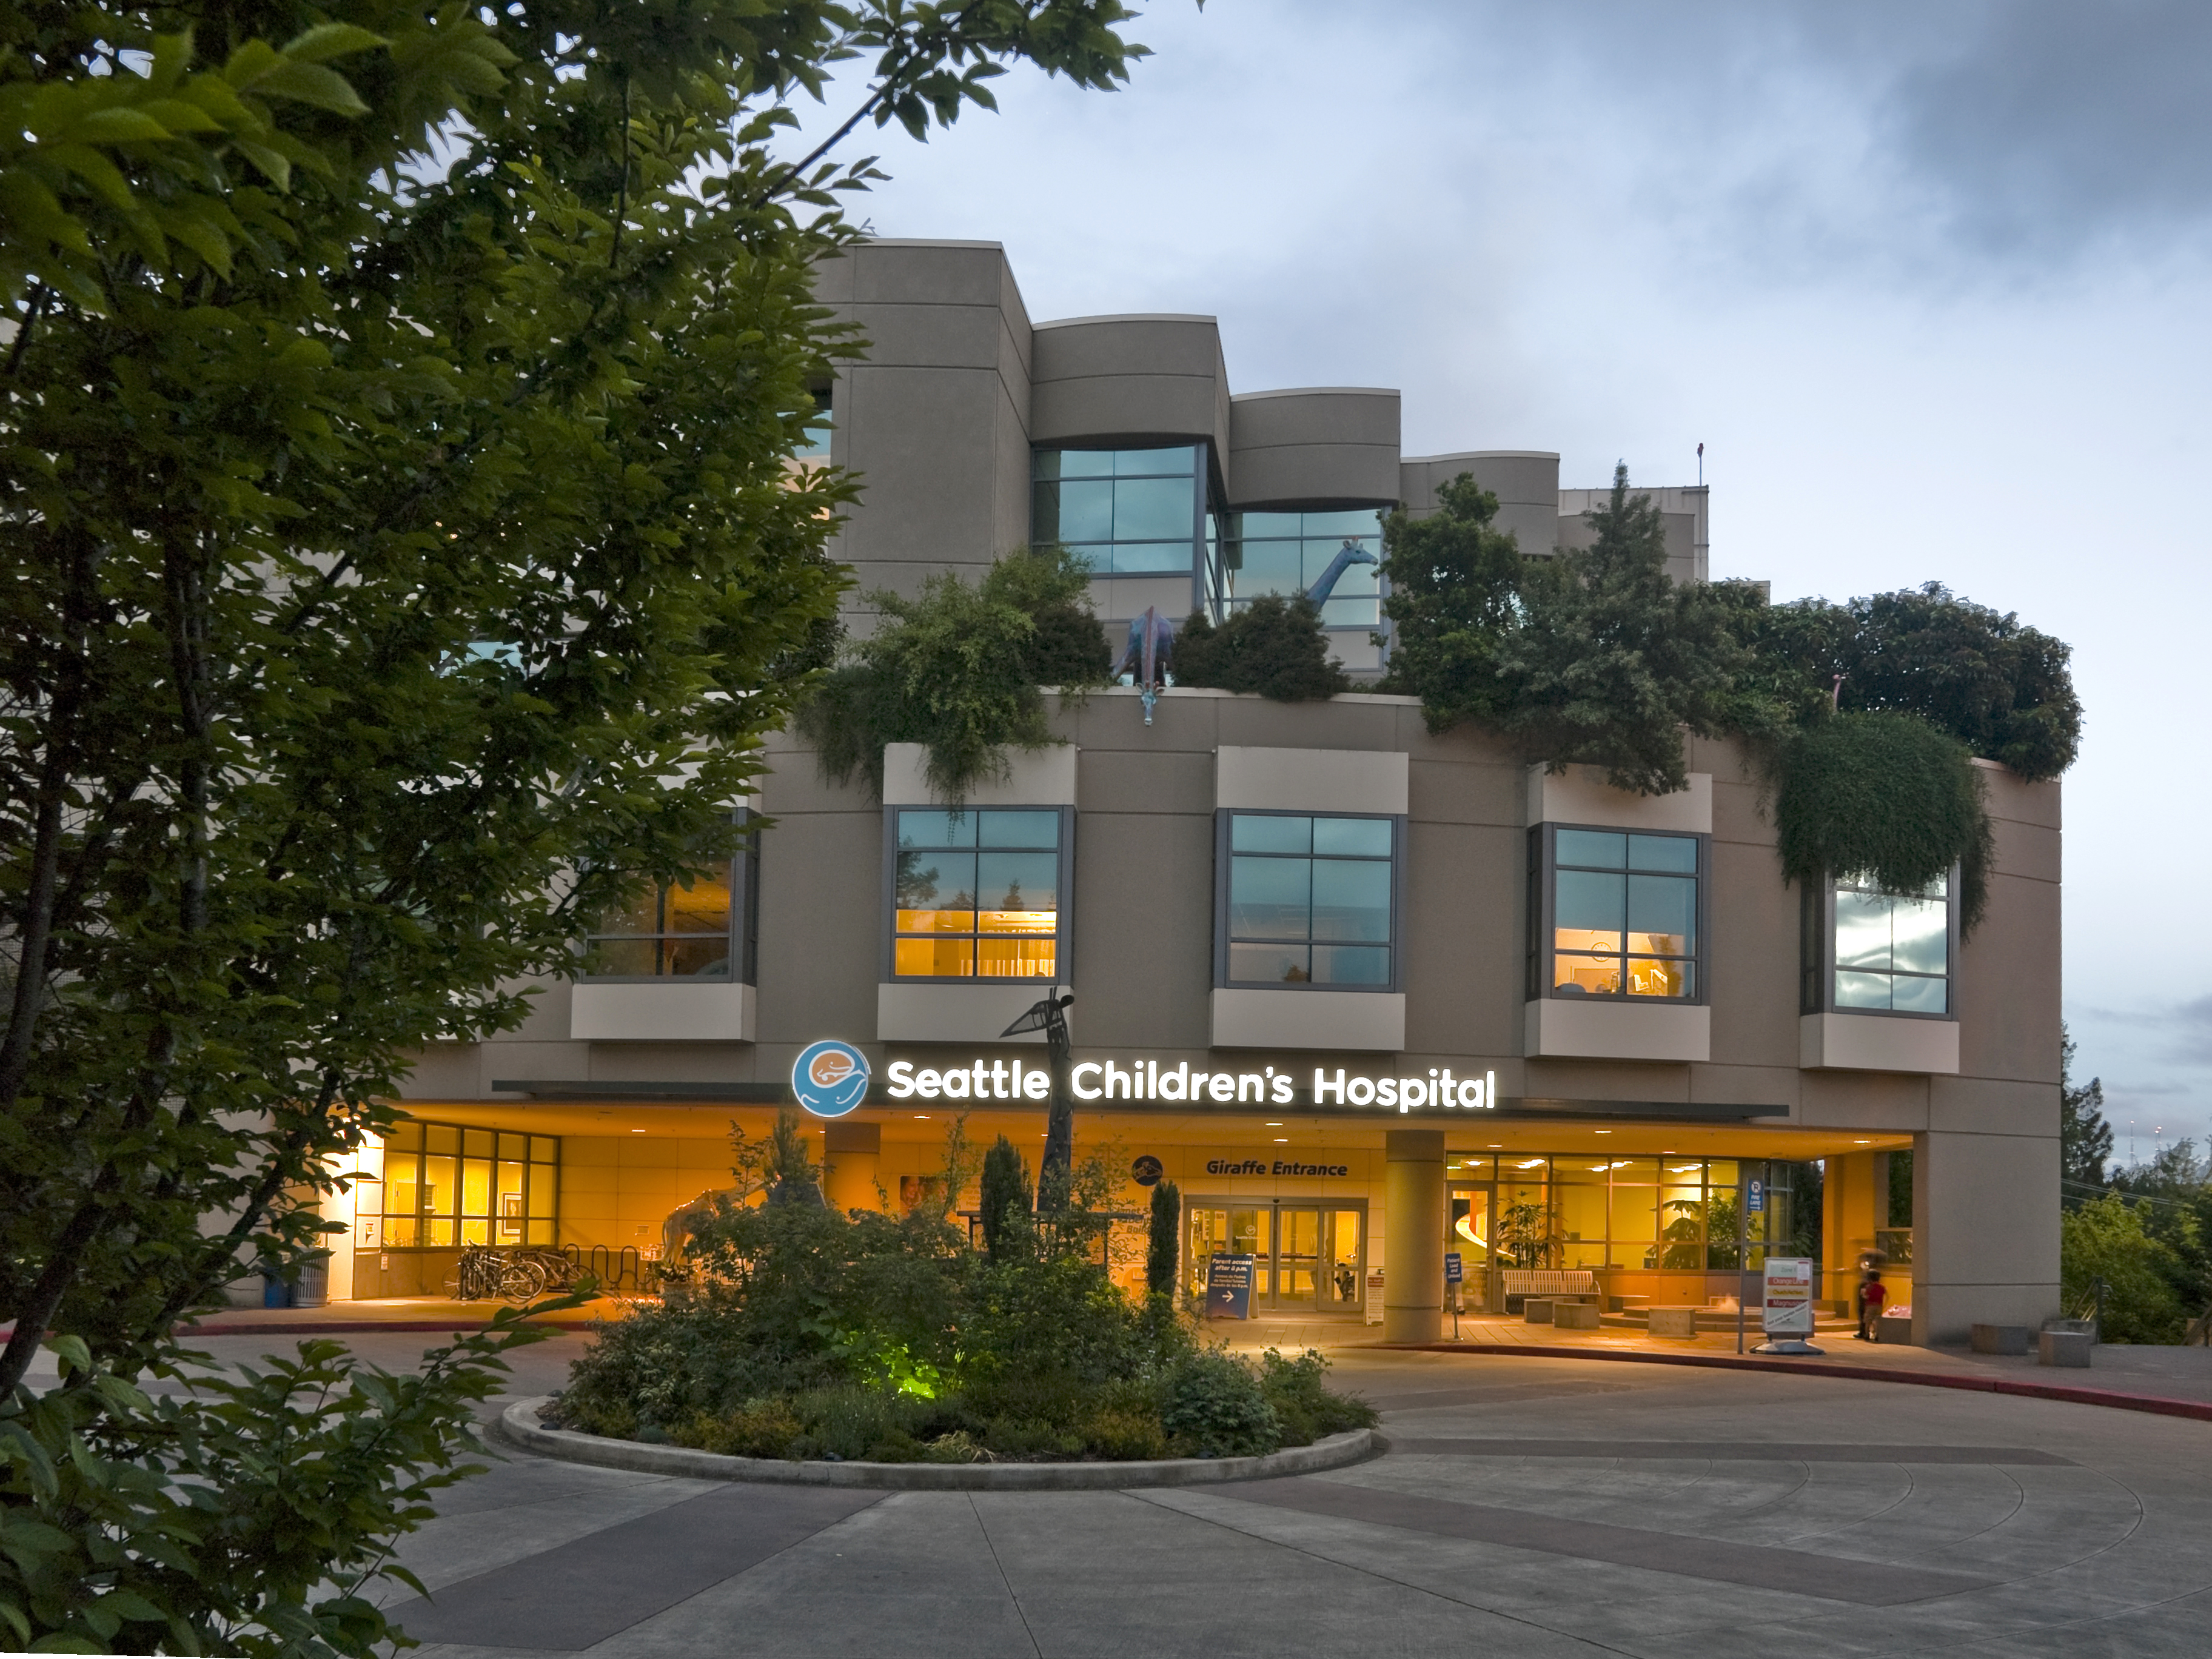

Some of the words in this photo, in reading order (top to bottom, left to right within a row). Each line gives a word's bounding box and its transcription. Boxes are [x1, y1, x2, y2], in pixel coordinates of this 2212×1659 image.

[887, 1059, 1050, 1099] Seattle
[1071, 1060, 1293, 1103] Children's
[1315, 1068, 1495, 1113] Hospital
[1207, 1160, 1267, 1175] Giraffe
[1272, 1161, 1348, 1176] Entrance
